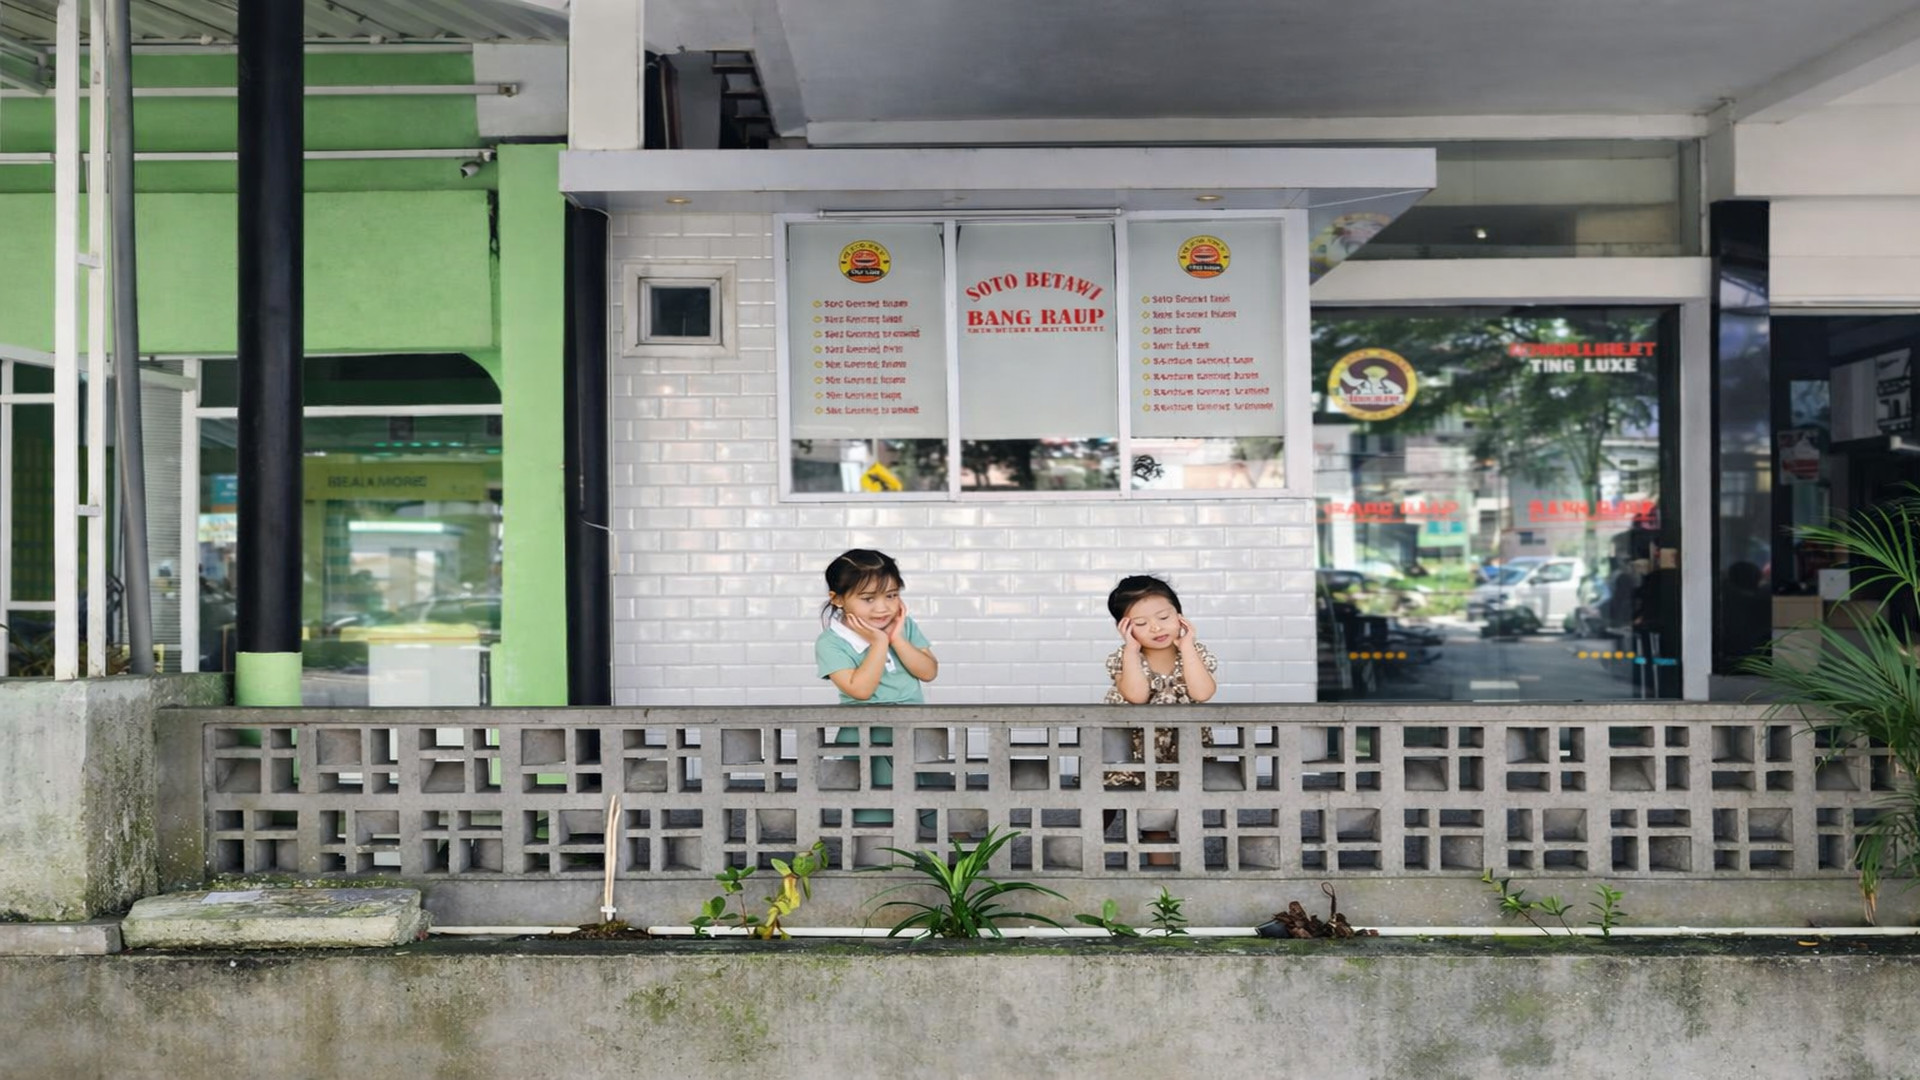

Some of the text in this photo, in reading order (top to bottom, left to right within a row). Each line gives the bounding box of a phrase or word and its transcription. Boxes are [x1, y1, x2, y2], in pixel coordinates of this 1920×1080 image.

[966, 272, 1103, 302] SOTO BETAWI
[967, 309, 1105, 325] BANG RAUP
[1529, 358, 1637, 373] TING LUXE
